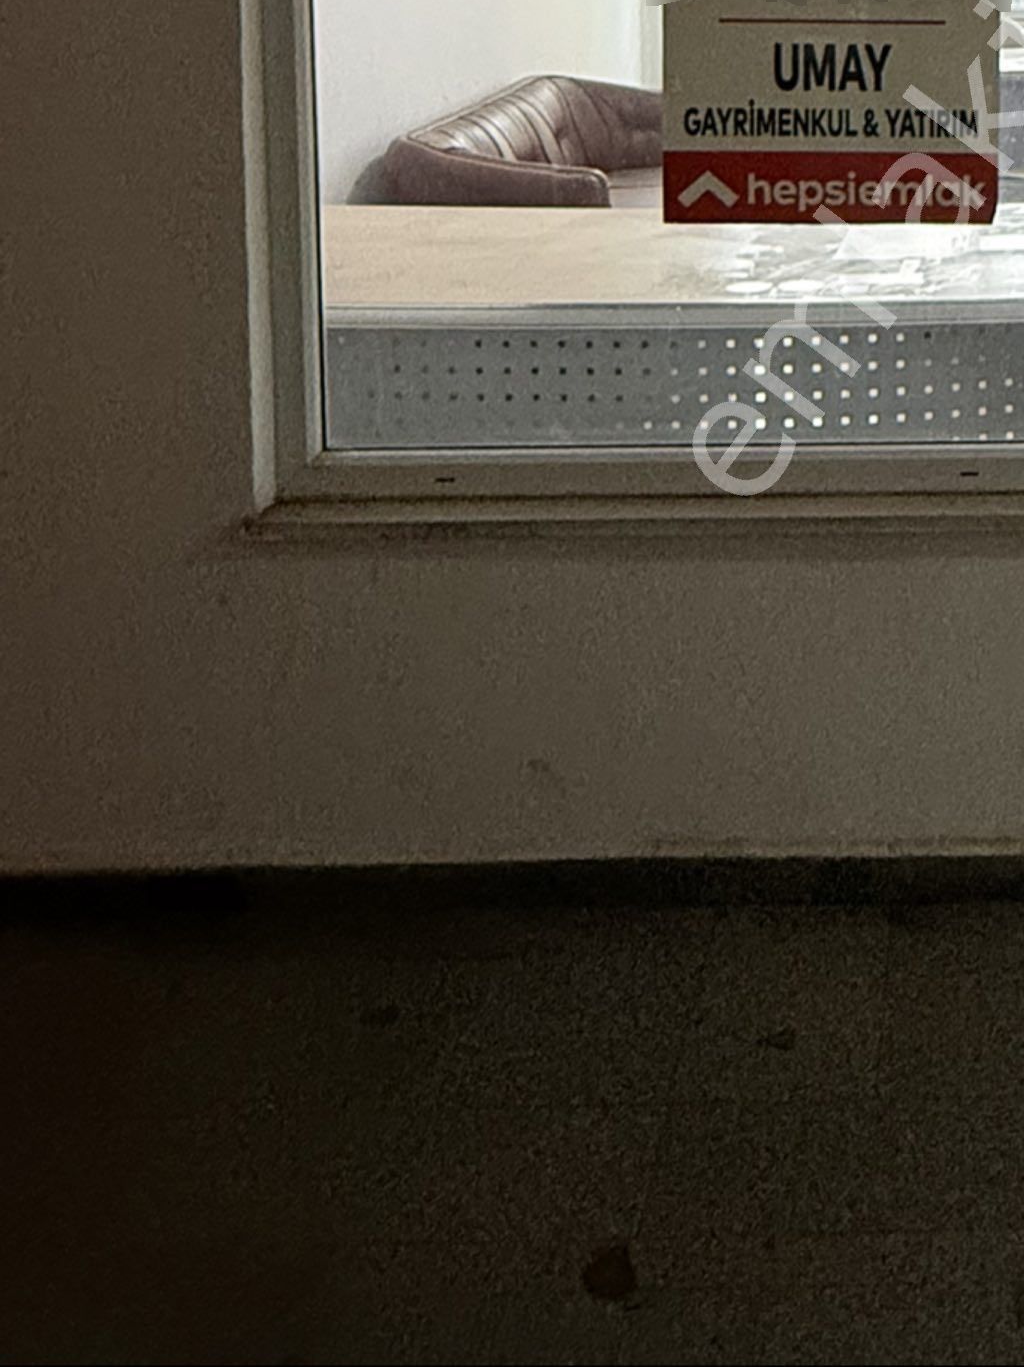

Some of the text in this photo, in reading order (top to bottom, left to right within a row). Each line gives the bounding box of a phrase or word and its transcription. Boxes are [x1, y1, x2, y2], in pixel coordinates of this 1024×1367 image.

[773, 42, 892, 92] UMAY
[683, 99, 980, 139] GAYRİMENKUL & YATIRIM
[747, 172, 988, 212] hepsiemlak
